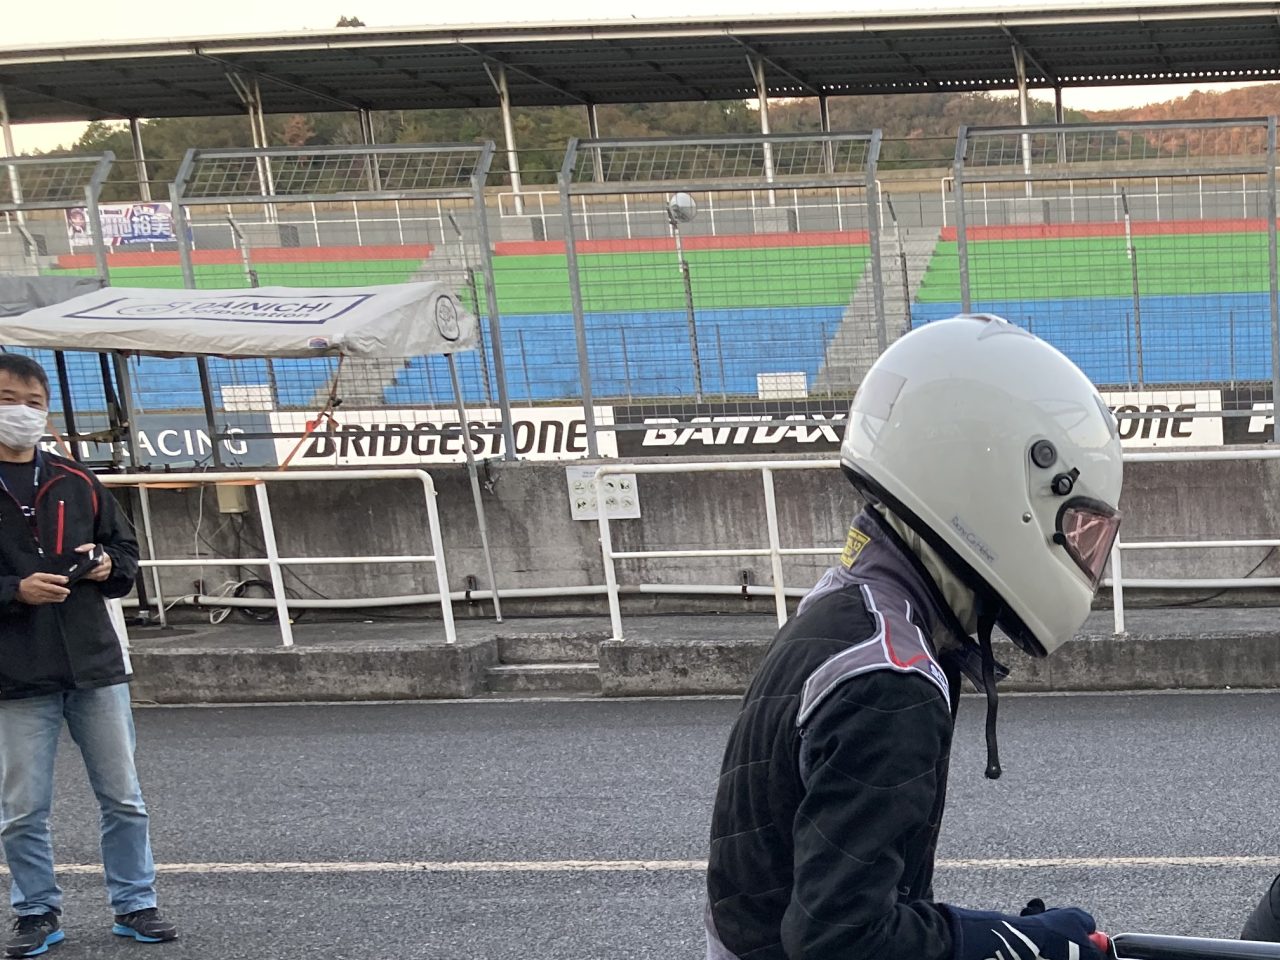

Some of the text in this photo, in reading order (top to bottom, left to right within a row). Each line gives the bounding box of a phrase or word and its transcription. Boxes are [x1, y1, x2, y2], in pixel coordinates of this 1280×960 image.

[190, 301, 333, 312] DAINICHI
[642, 413, 846, 447] BATTLAX
[1111, 404, 1196, 441] ONE
